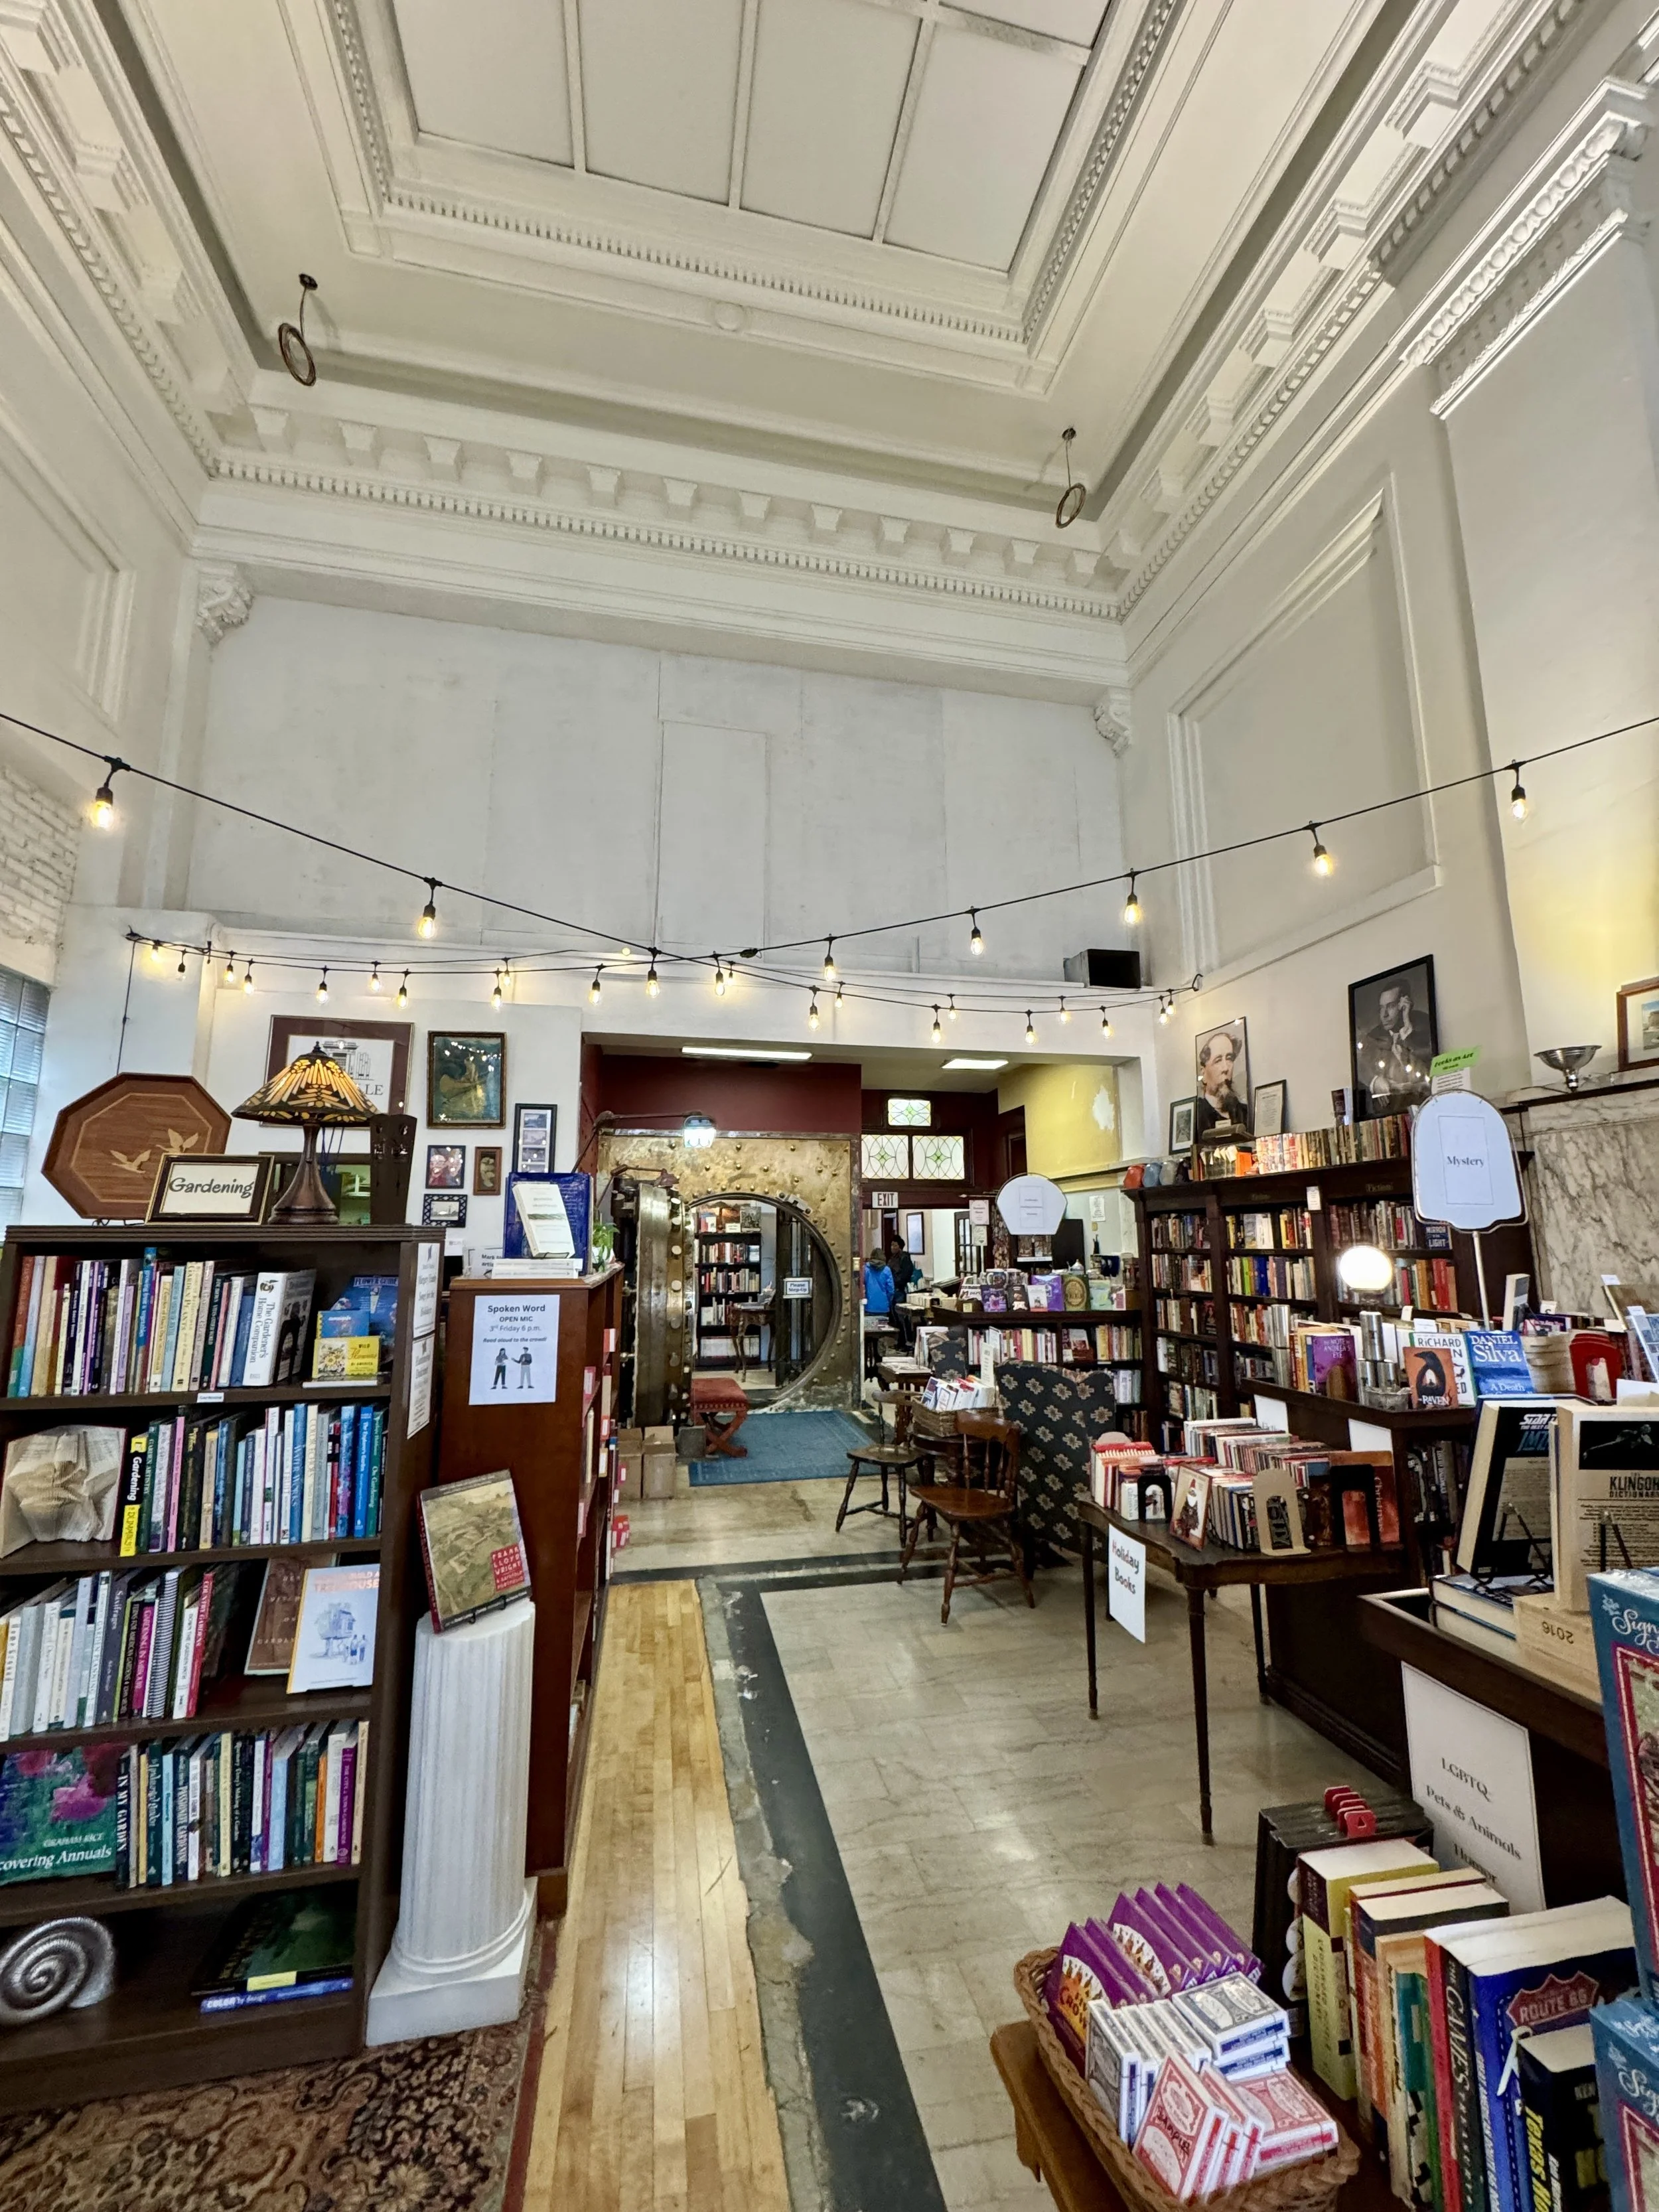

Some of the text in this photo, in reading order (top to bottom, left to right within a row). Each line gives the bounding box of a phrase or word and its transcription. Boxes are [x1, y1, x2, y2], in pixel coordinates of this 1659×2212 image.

[1447, 1155, 1484, 1168] Mystery
[169, 1177, 254, 1198] Gardening
[877, 1193, 895, 1207] EXIT
[1429, 1239, 1445, 1248] LIGHT
[488, 1305, 520, 1314] Spoken
[250, 1297, 267, 1363] Home Companion
[259, 1302, 275, 1359] The Gardener's
[1469, 1335, 1518, 1345] DANIEL
[1473, 1345, 1522, 1363] Silva
[1499, 1382, 1526, 1392] Death
[1421, 1395, 1450, 1406] RAVEN
[127, 1456, 142, 1501] Gardening
[493, 1554, 520, 1568] LLOYD
[1112, 1539, 1140, 1575] Holiday
[1115, 1566, 1136, 1595] Books
[199, 1580, 210, 1613] COUNTRY
[117, 1774, 129, 1787] IN
[1441, 1757, 1491, 1803] LGBTQ
[116, 1809, 128, 1852] GARDEN
[1426, 1784, 1522, 1860] Pets & Animals
[56, 1844, 112, 1865] Annuals
[1520, 1994, 1565, 2024] ROUTE
[1526, 2106, 1546, 2181] TEXAS
